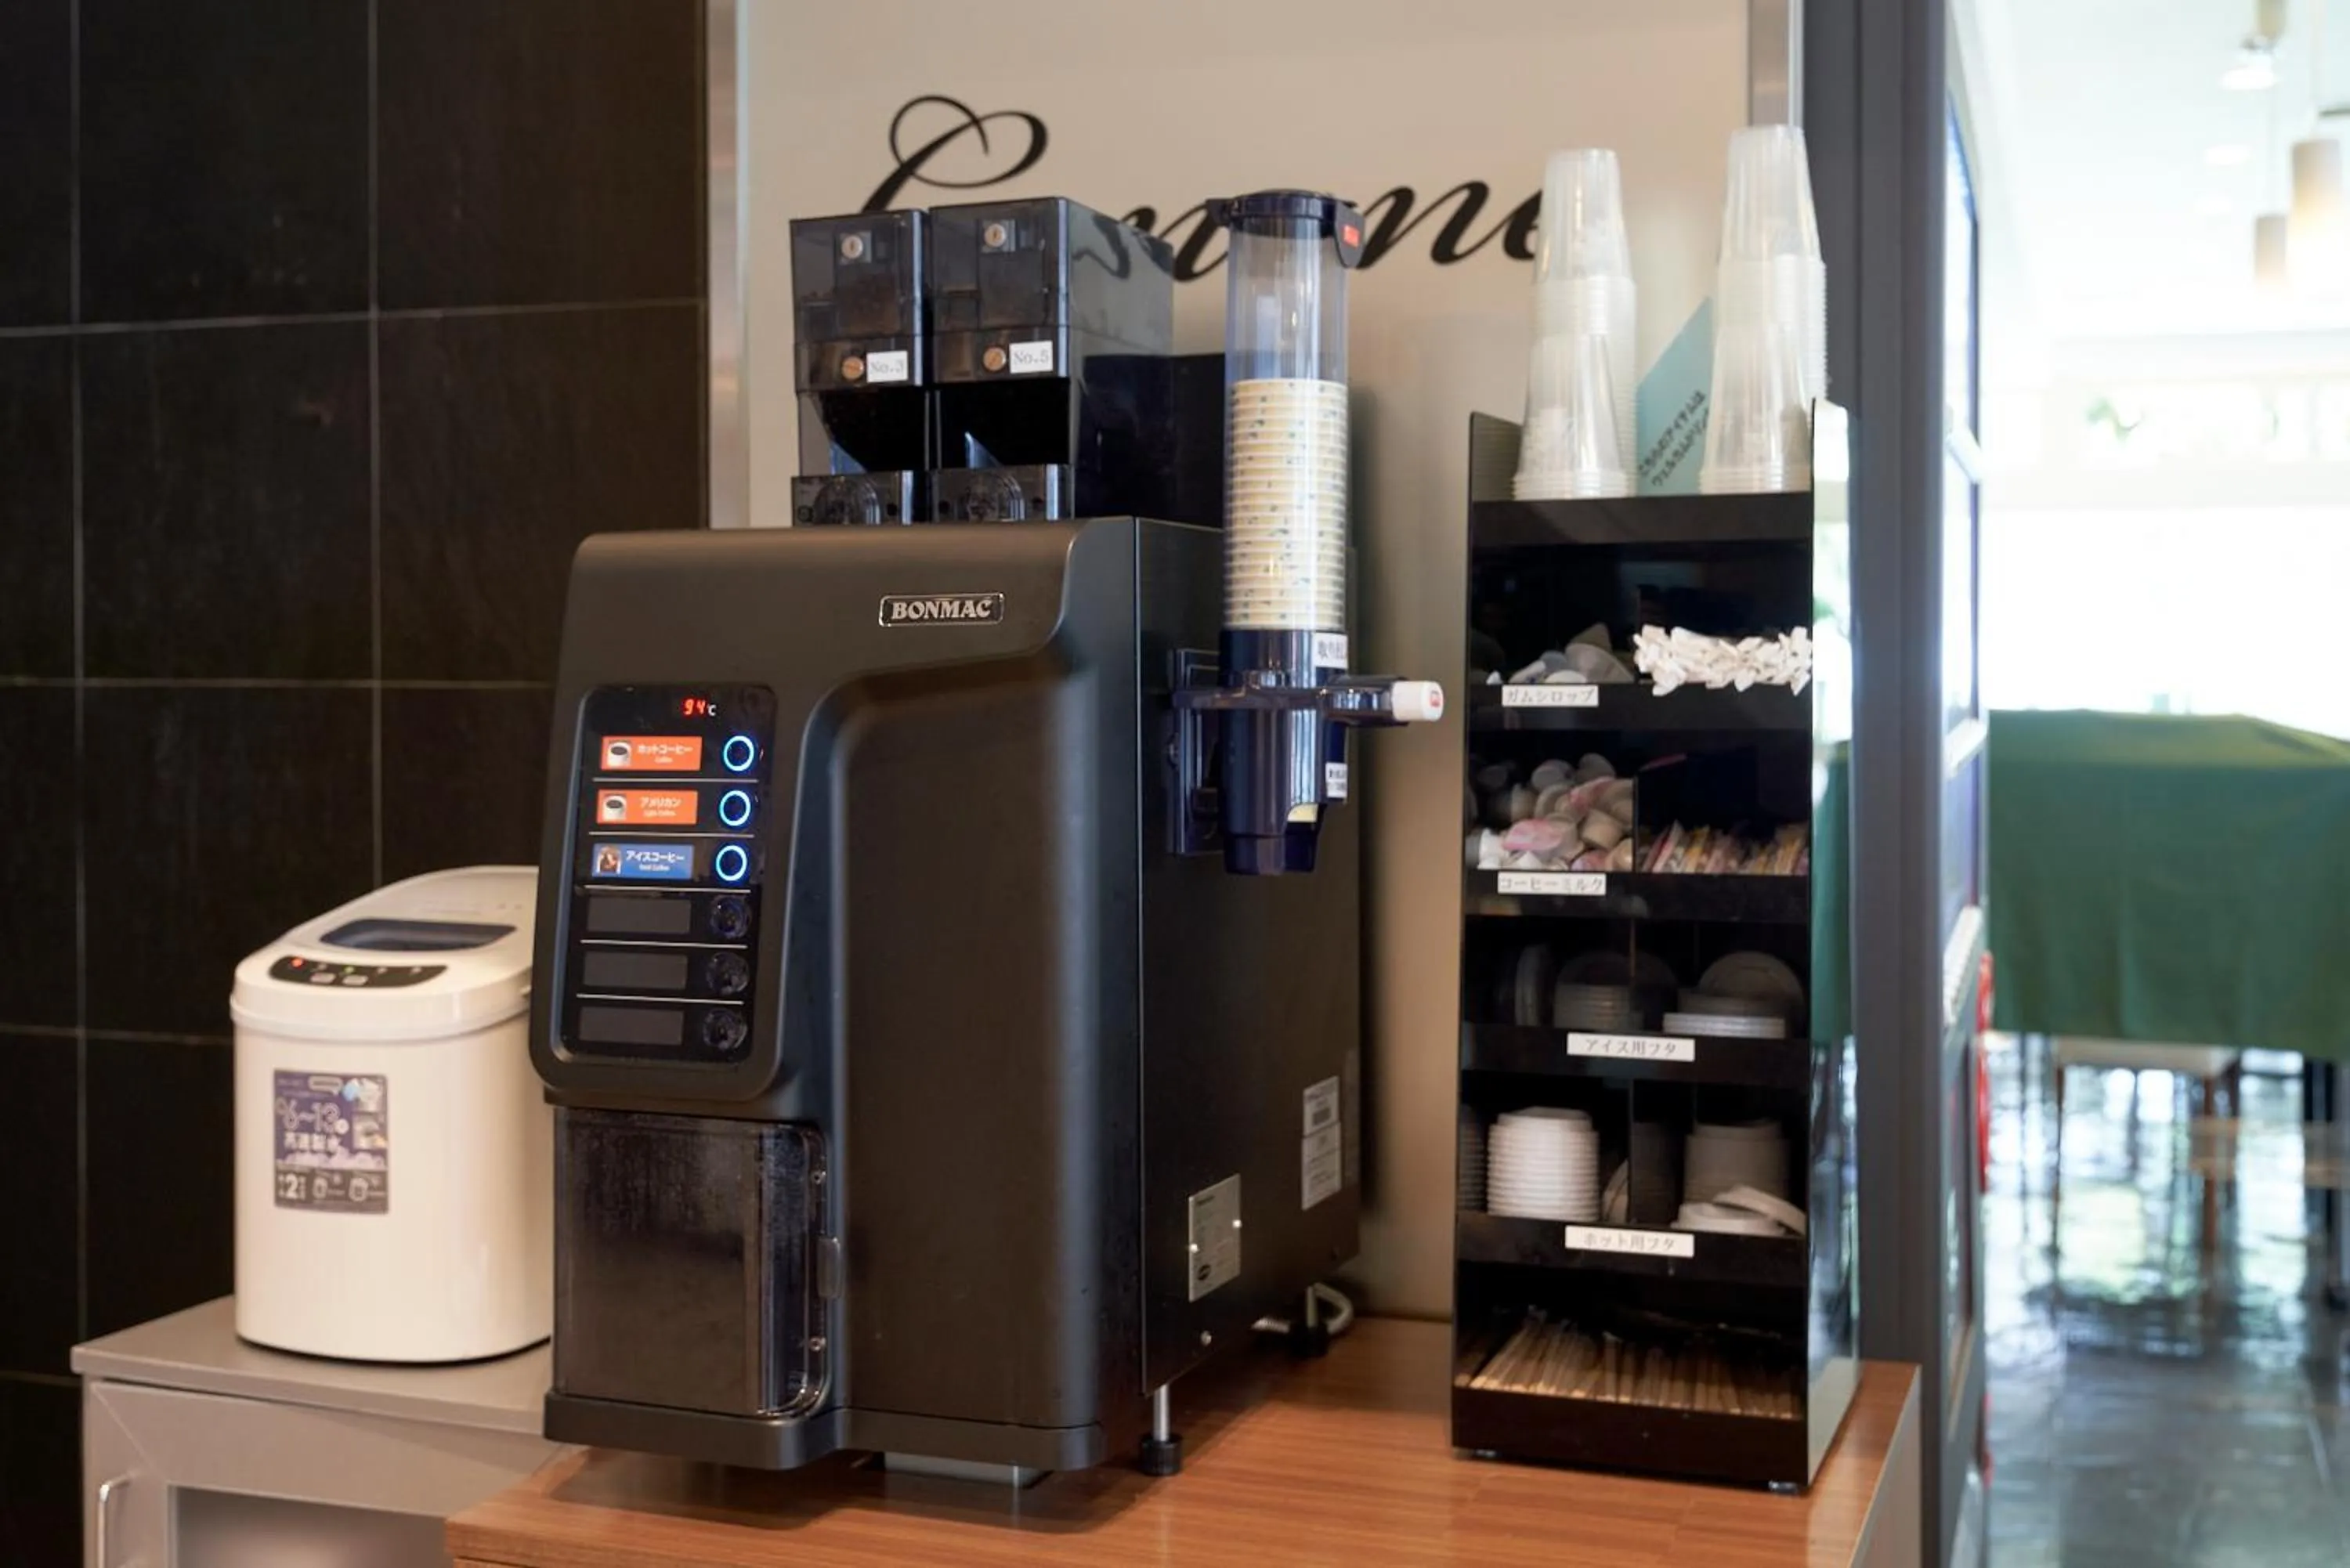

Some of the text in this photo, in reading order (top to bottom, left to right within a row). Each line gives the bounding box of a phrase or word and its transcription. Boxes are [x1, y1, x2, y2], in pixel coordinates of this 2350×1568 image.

[891, 600, 992, 620] BONMAC
[1507, 688, 1595, 703] ガムシロップ
[627, 851, 685, 862] アイスコーヒー
[1499, 876, 1603, 891] コーヒーミルク
[1585, 1039, 1677, 1055] アイス用フタ
[1583, 1234, 1675, 1252] ホット用フタ
